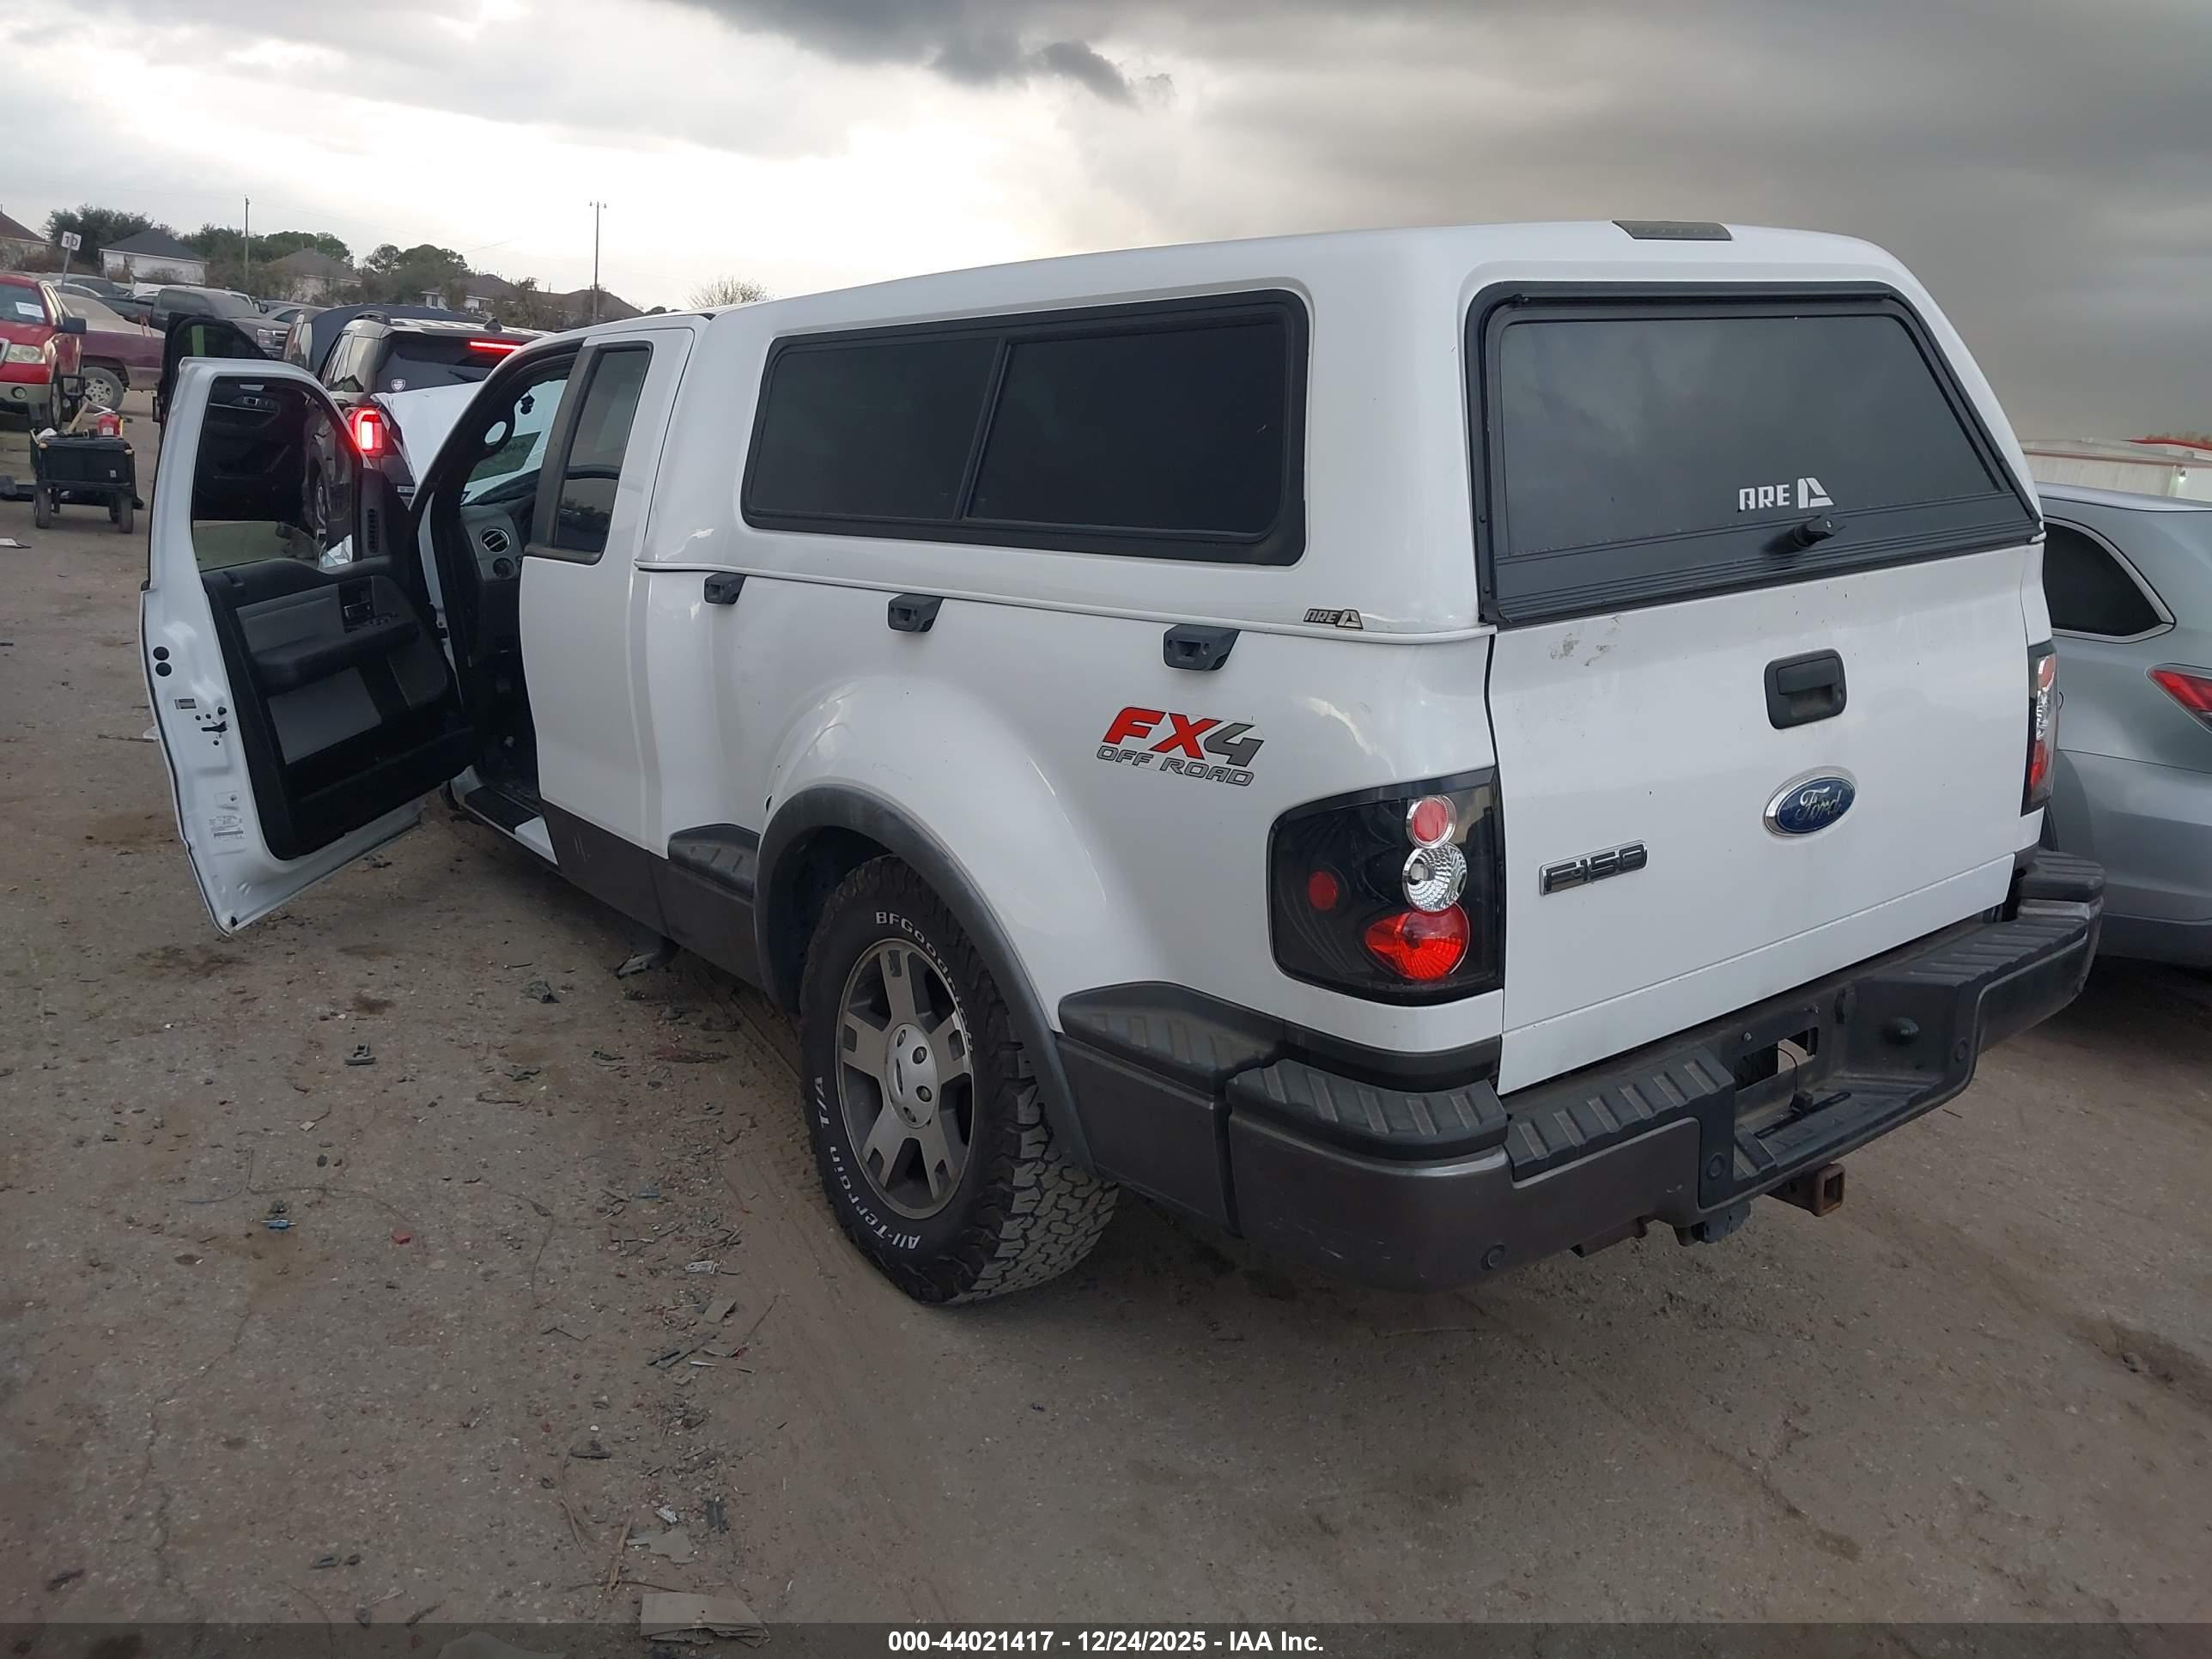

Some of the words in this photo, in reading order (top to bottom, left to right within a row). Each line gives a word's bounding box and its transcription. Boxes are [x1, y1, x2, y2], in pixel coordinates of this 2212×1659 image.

[1739, 483, 1790, 511] ARE
[1103, 707, 1265, 767] FX4
[1097, 745, 1153, 766] OFF
[1159, 757, 1254, 787] ROAD
[1795, 786, 1843, 822] Ford
